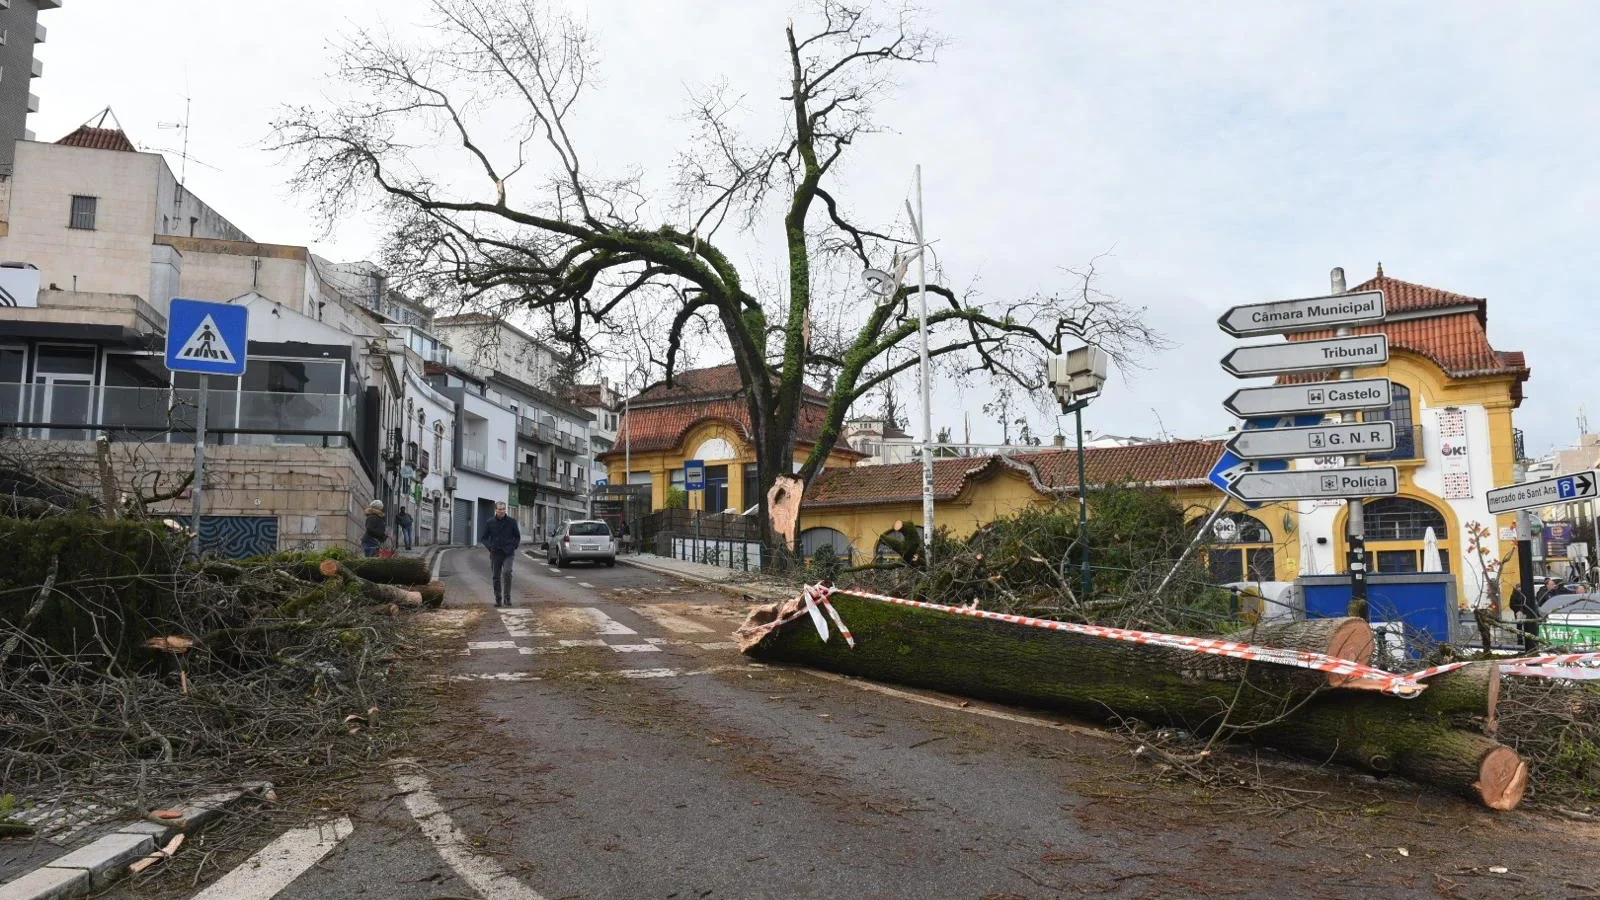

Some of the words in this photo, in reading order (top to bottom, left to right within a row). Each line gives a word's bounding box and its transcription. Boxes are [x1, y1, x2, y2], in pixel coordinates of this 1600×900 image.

[1252, 309, 1303, 323] Câmara
[1307, 300, 1375, 318] Municipal
[1321, 344, 1378, 359] Tribunal
[1328, 387, 1381, 401] Castelo
[1329, 433, 1345, 445] G.
[1370, 431, 1385, 442] R.
[1342, 475, 1387, 488] Polícia
[1489, 492, 1516, 505] mercado
[1518, 491, 1525, 500] de
